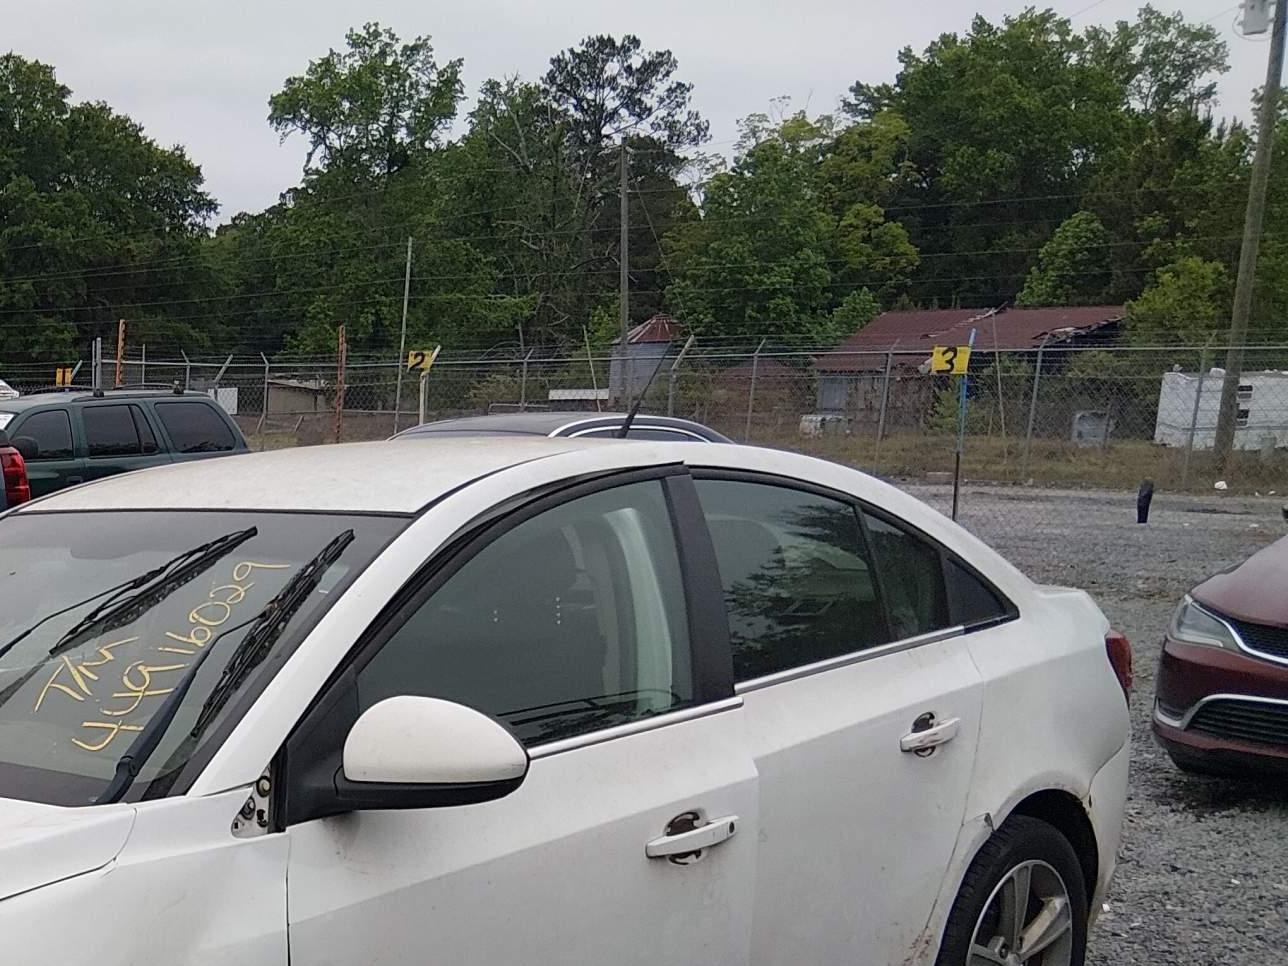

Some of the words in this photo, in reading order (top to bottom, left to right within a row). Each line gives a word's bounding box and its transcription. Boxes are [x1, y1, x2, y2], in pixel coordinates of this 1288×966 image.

[410, 351, 426, 370] 2
[935, 346, 958, 374] 3
[71, 561, 292, 752] 44916029
